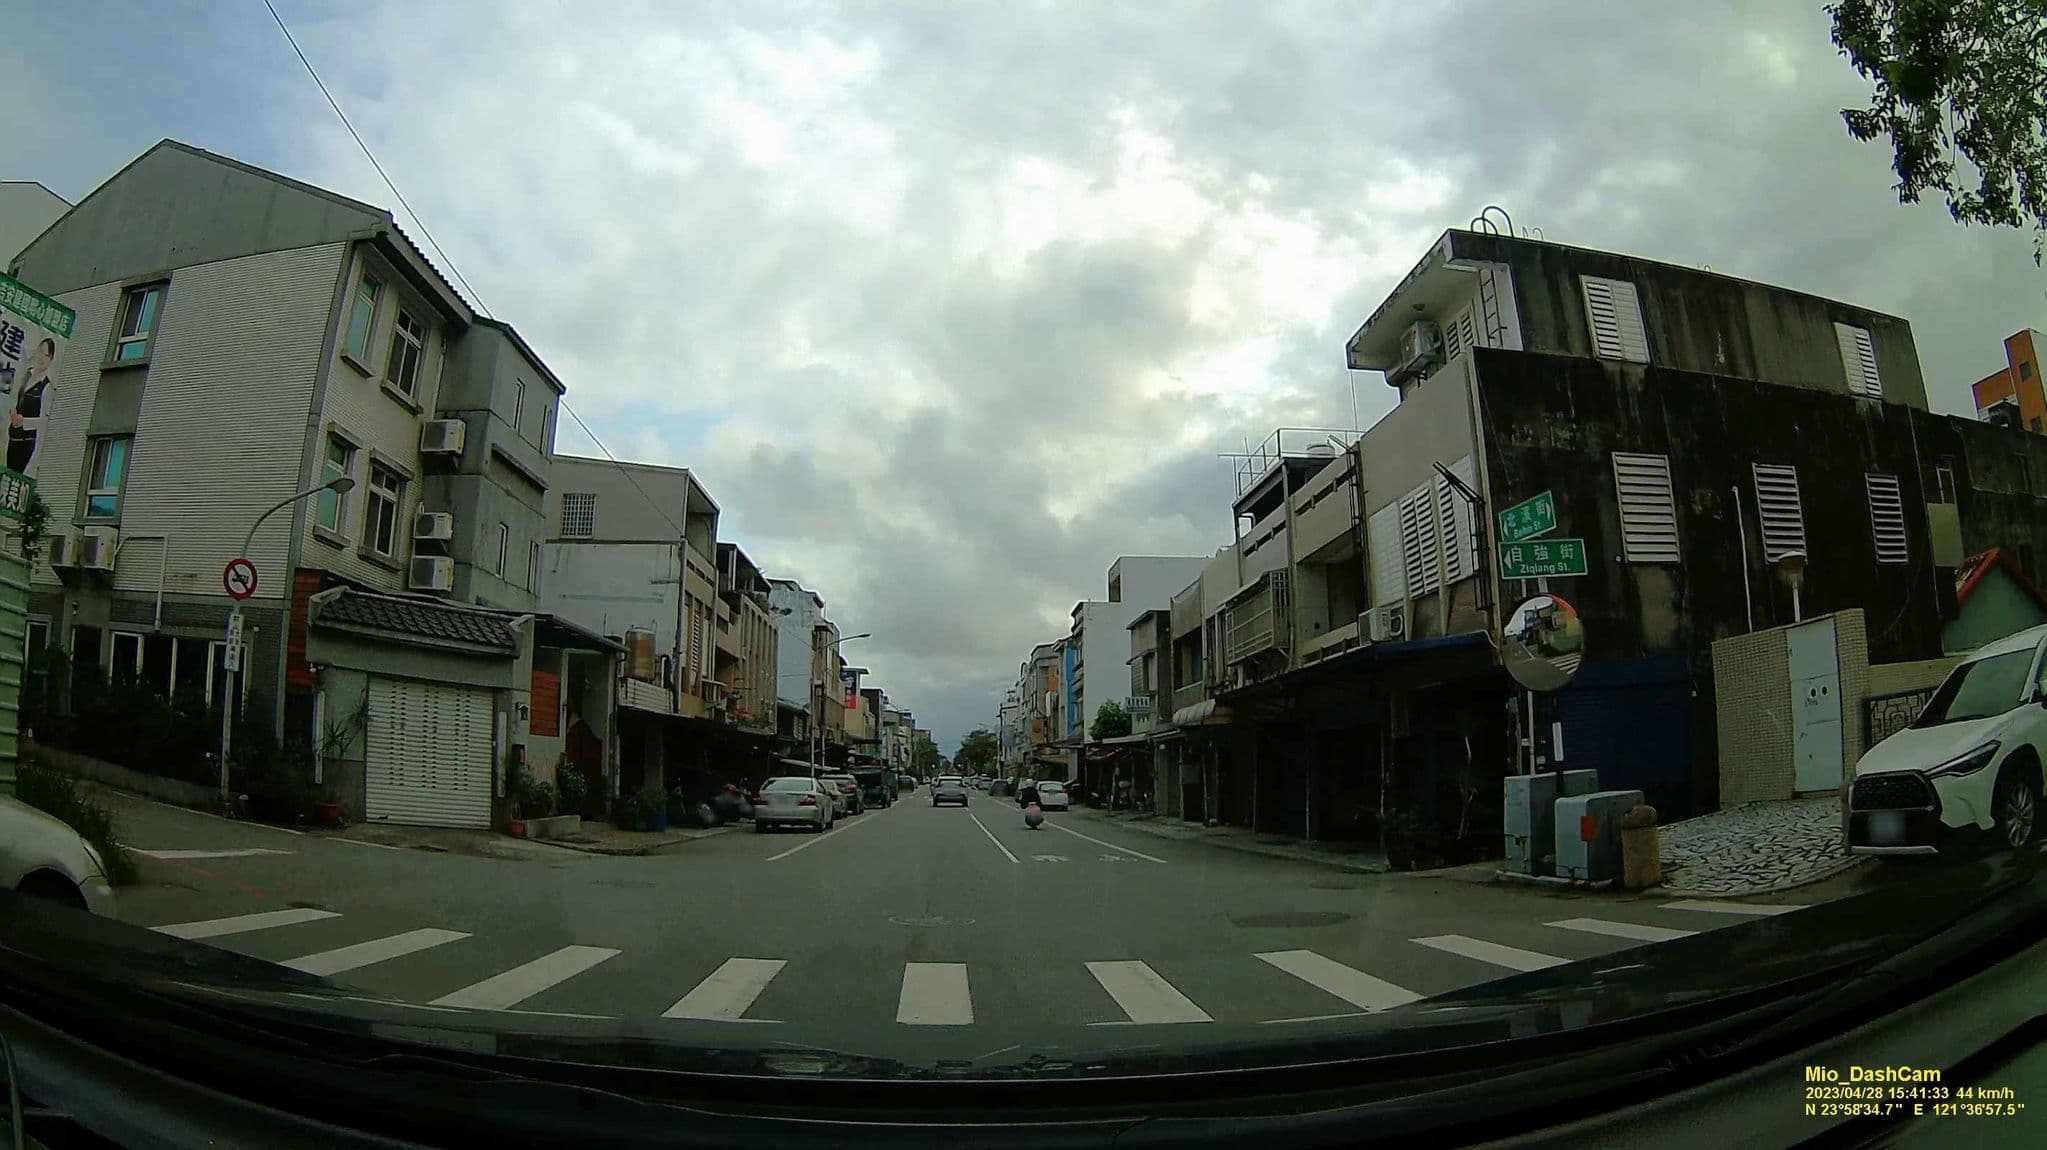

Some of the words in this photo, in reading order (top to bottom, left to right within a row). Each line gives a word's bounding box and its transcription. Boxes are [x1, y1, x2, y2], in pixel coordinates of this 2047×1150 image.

[1511, 543, 1574, 563] 自強街
[1520, 562, 1555, 574] Ziqiang
[1558, 561, 1571, 572] St.
